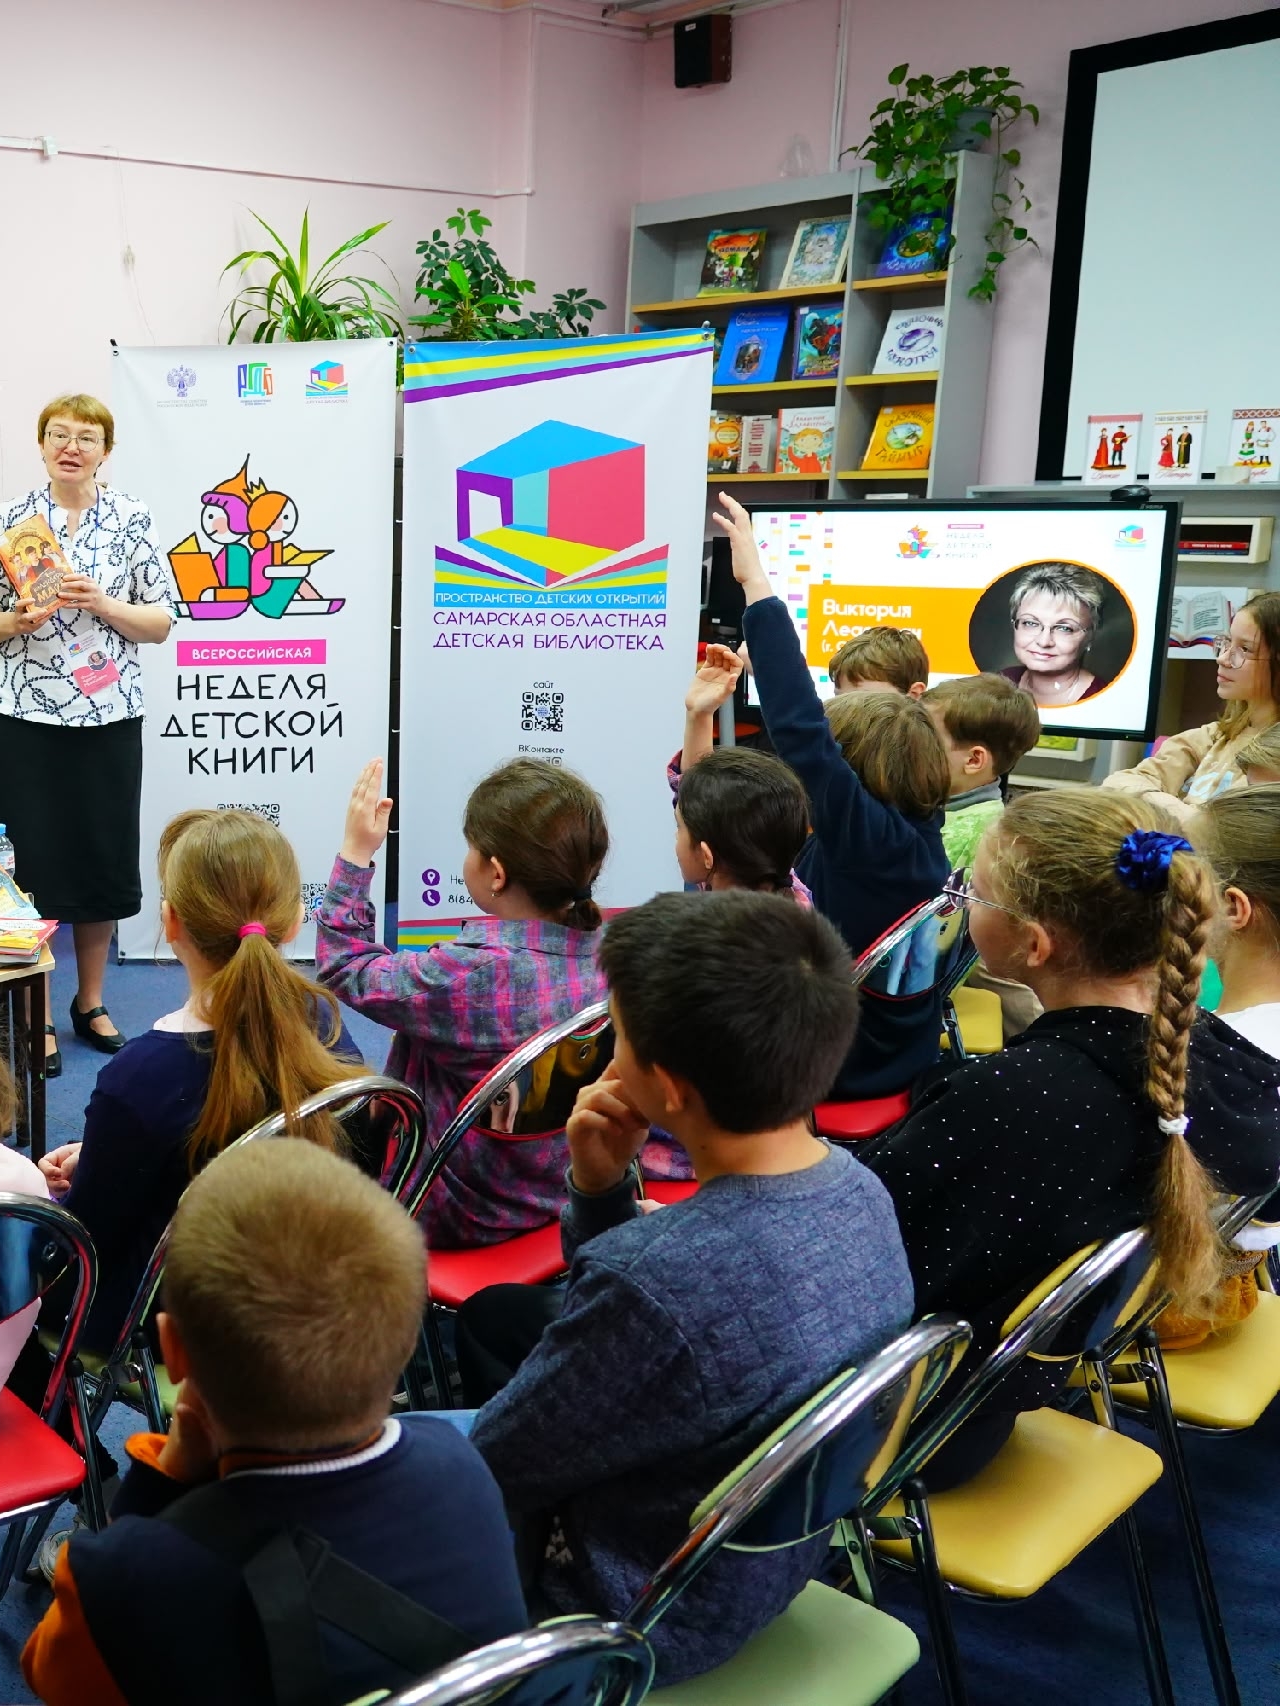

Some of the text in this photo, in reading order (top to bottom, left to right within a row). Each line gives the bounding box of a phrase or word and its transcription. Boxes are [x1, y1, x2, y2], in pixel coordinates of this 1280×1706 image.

[435, 591, 665, 605] ПРОСТРАНСТВО ДЕТСКИХ ОТКРЫТИЙ
[822, 598, 913, 622] Виктория
[433, 611, 667, 628] САМАРСКАЯ ОБЛАСТНАЯ
[433, 632, 665, 651] ДЕТСКАЯ БИБЛИОТЕКА
[192, 646, 312, 661] ВСЕРОССИЙСКАЯ
[177, 673, 326, 701] НЕДЕЛЯ
[532, 681, 554, 689] сайт
[160, 702, 343, 739] ДЕТСКОЙ
[518, 744, 565, 754] ВКонтакте
[188, 746, 314, 775] КНИГИ
